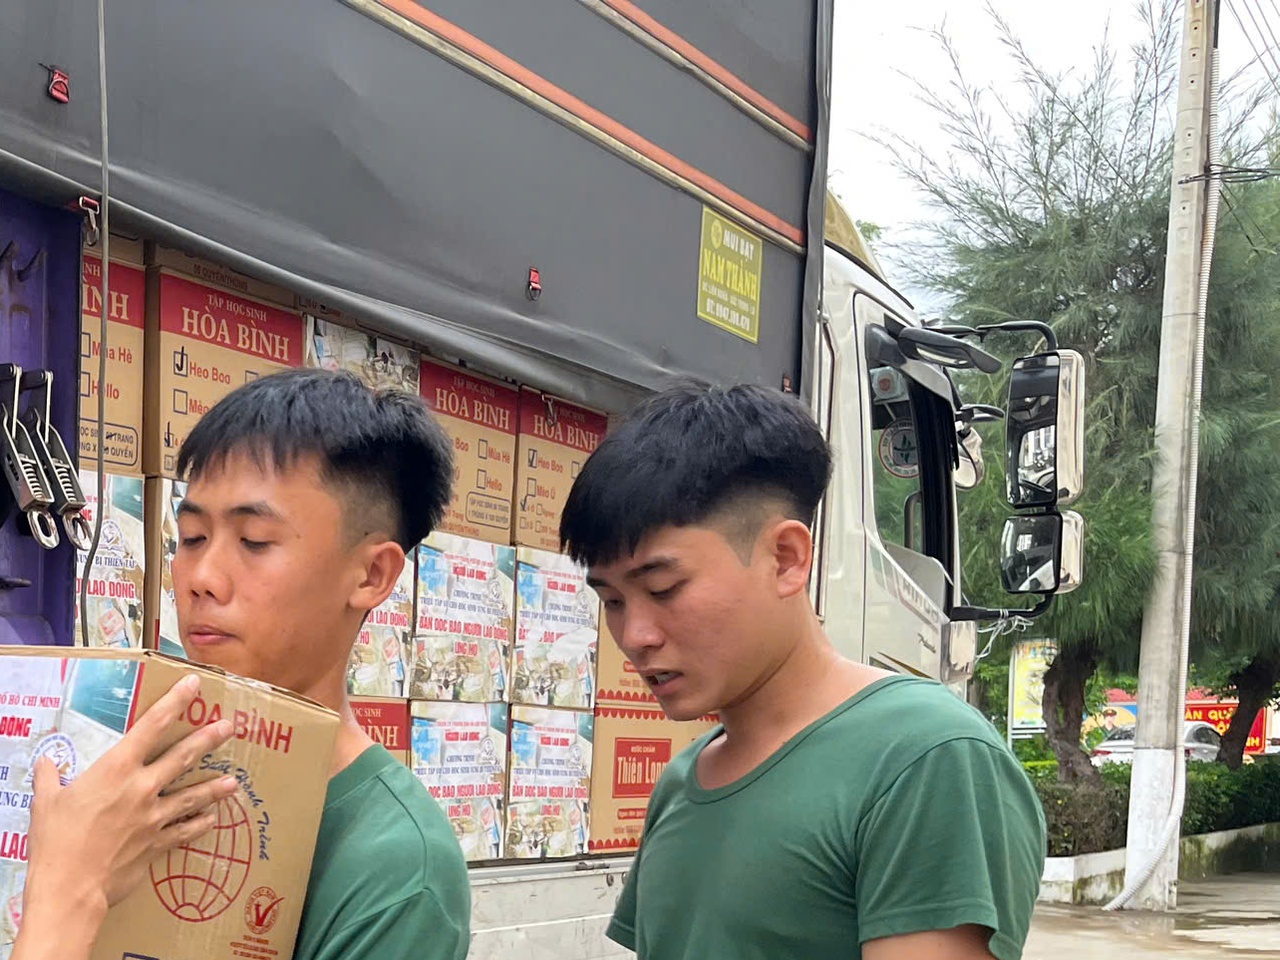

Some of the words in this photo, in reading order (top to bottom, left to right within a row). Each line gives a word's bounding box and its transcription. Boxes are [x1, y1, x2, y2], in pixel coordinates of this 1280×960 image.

[703, 249, 726, 285] NAM
[226, 300, 246, 317] HỌC
[246, 308, 267, 322] SINH
[182, 306, 231, 344] HÒA
[237, 320, 289, 361] BÌNH
[119, 346, 132, 363] Hè
[190, 362, 209, 379] Heo
[212, 367, 230, 384] Boo
[92, 380, 119, 399] Hllo
[435, 386, 469, 418] HÒA
[473, 394, 510, 431] BÌNH
[567, 418, 599, 449] BÌNH
[487, 477, 502, 491] Hello
[88, 579, 106, 596] LAO
[376, 611, 387, 624] LAO
[38, 697, 60, 708] MINH
[364, 708, 382, 717] SINH
[233, 708, 293, 753] BÌNH
[618, 757, 642, 784] Thiên
